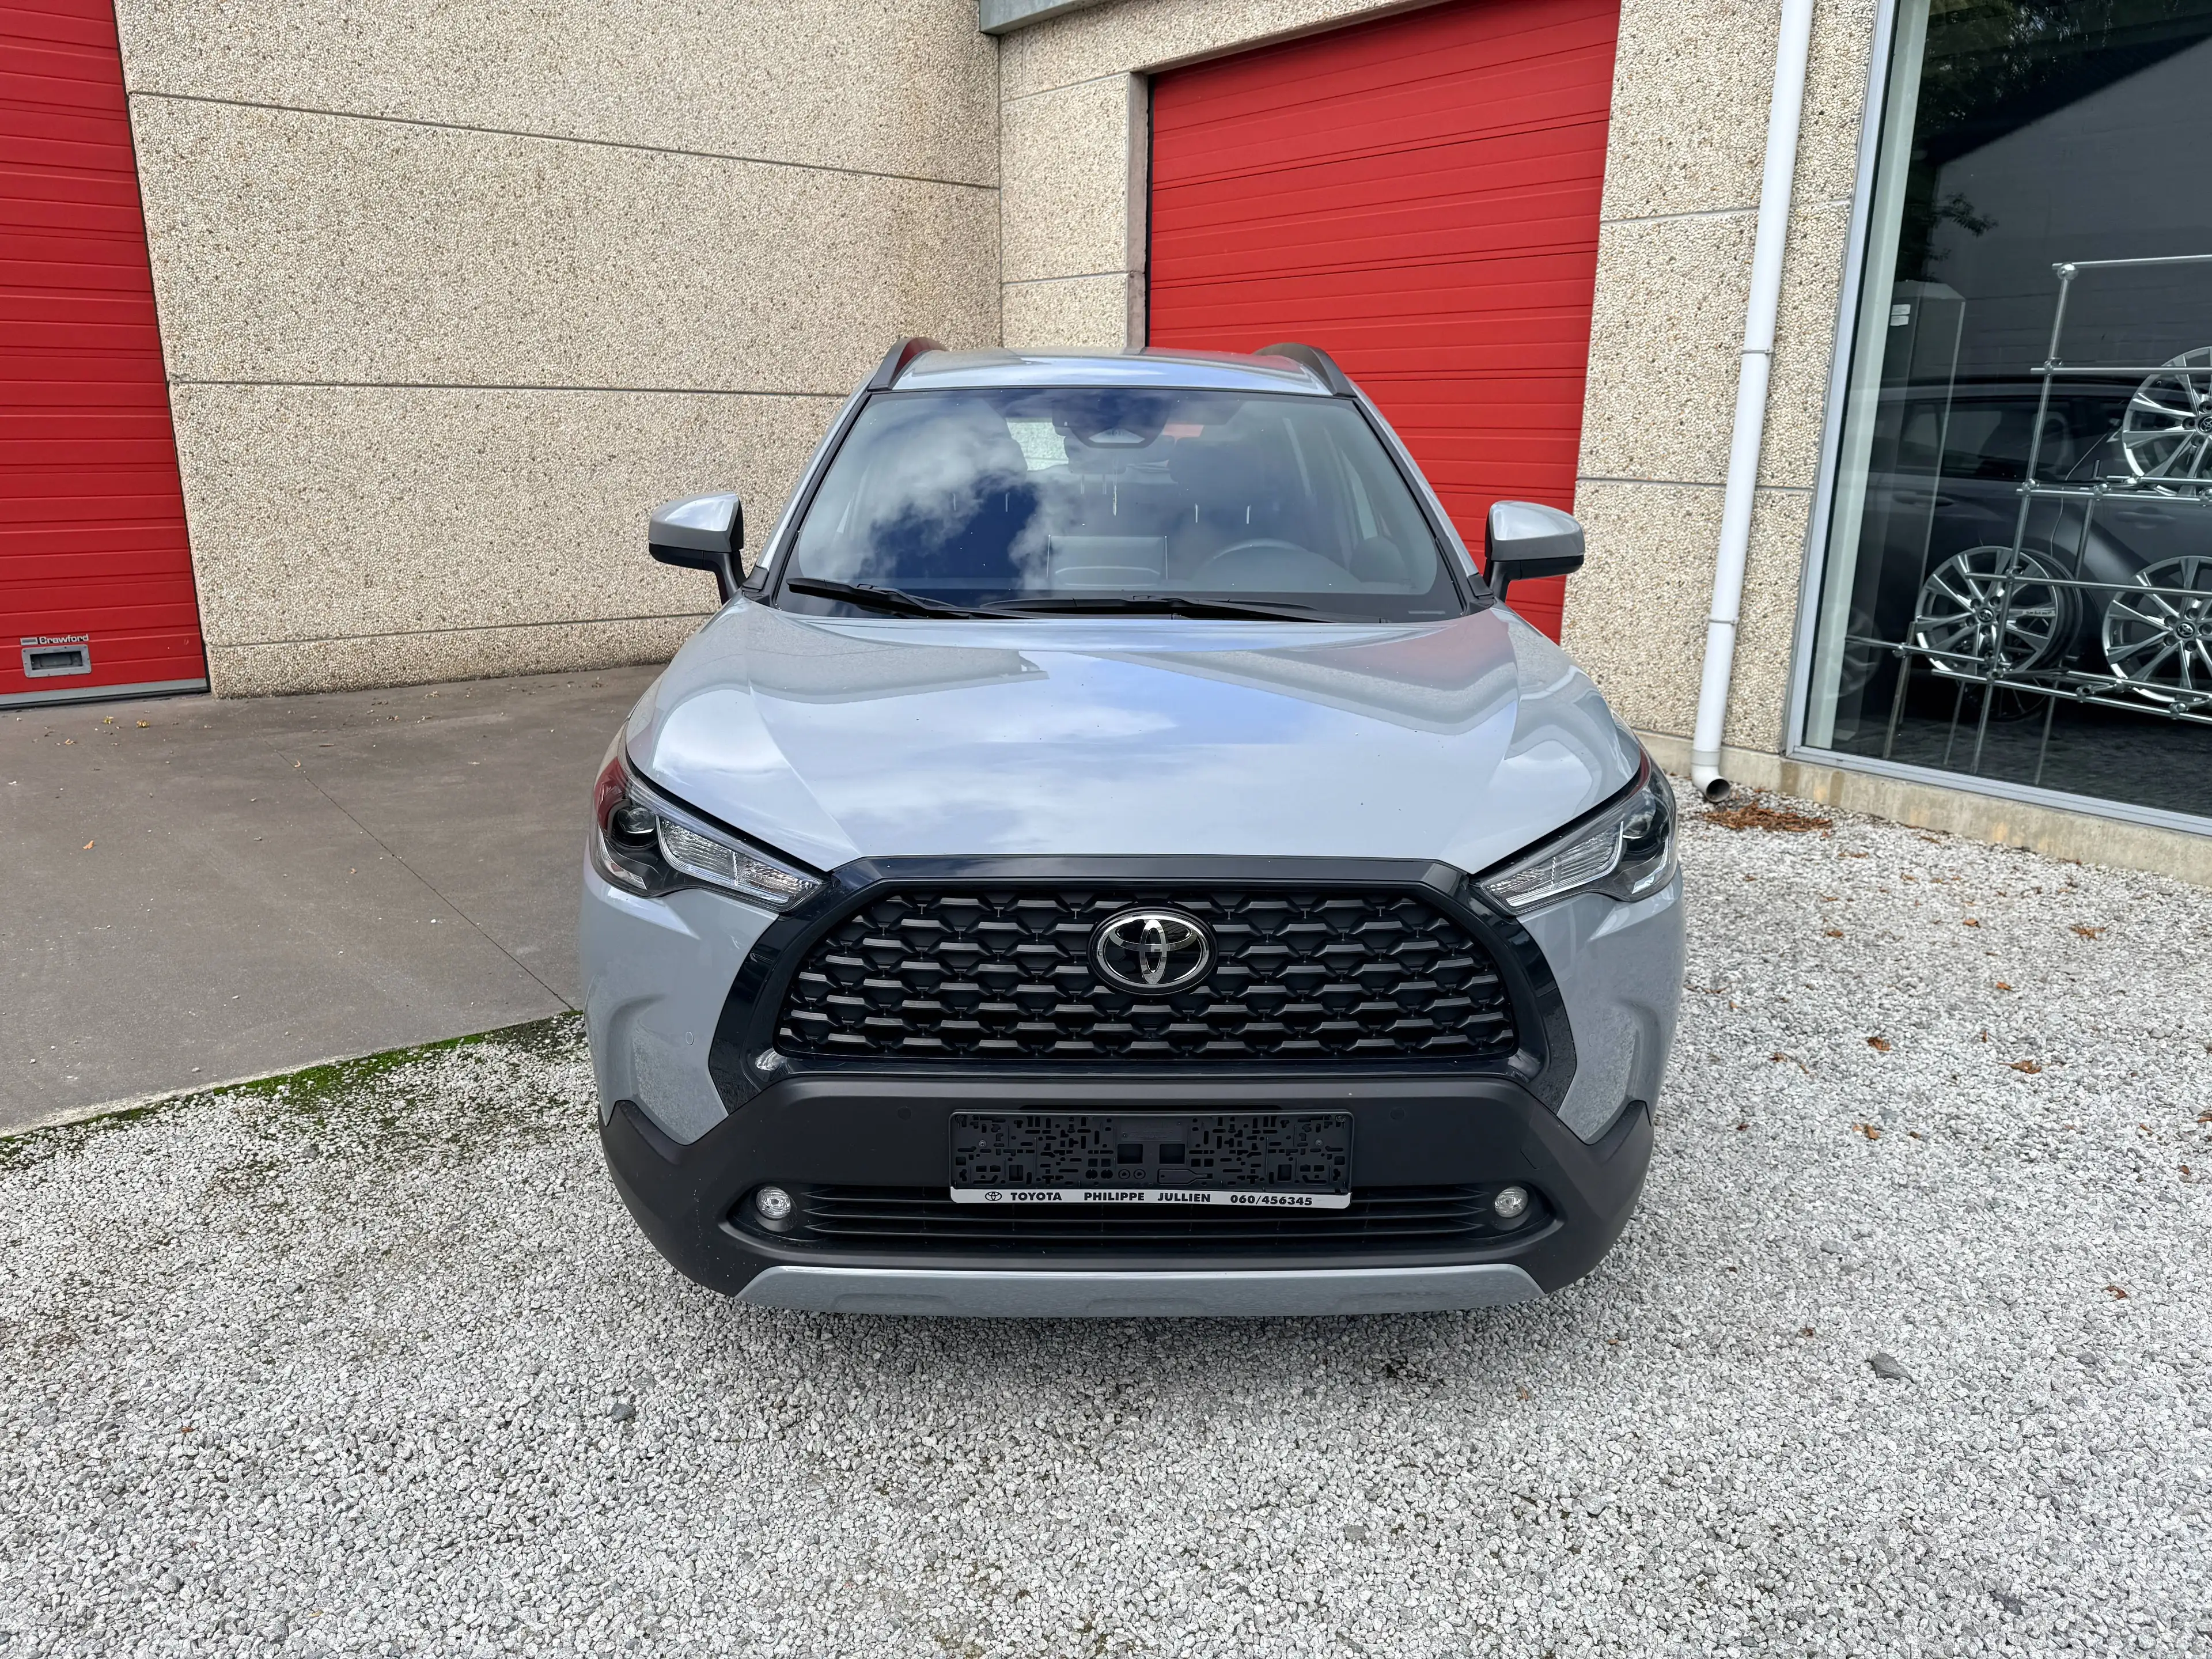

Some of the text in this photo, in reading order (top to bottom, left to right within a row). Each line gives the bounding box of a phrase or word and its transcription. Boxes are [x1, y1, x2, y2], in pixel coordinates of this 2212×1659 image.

[39, 633, 89, 645] Crawford
[1010, 1192, 1313, 1206] TOYOTA PHILIPPE JULLIEN 060/456345
